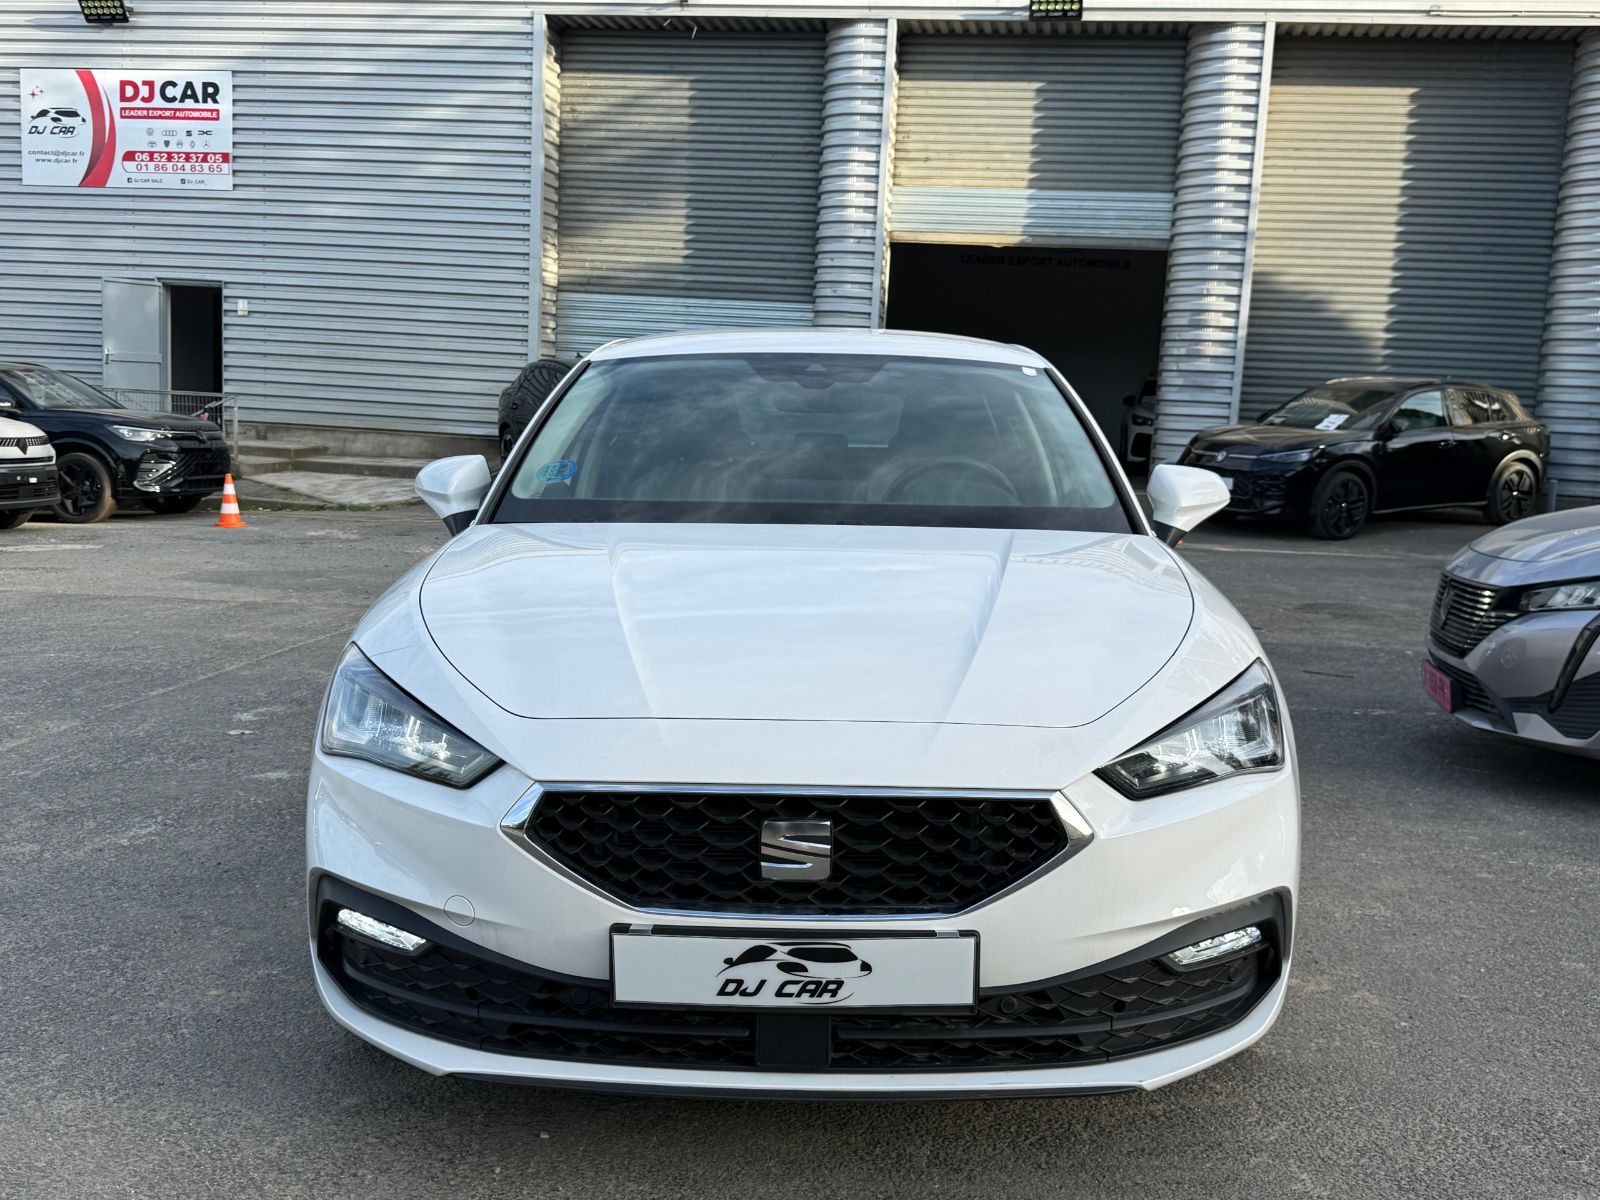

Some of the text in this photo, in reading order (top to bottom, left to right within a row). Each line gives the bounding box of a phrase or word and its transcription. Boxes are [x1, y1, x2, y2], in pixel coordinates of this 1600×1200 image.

[119, 80, 220, 104] DJ CAR
[28, 126, 76, 136] DJ CAR
[135, 153, 223, 163] 06 52 32 37 05
[135, 163, 223, 173] 01 86 04 83 65
[960, 254, 1132, 269] LEADER EXPORT AUTOMOBILE
[716, 979, 845, 998] DJ CAR
